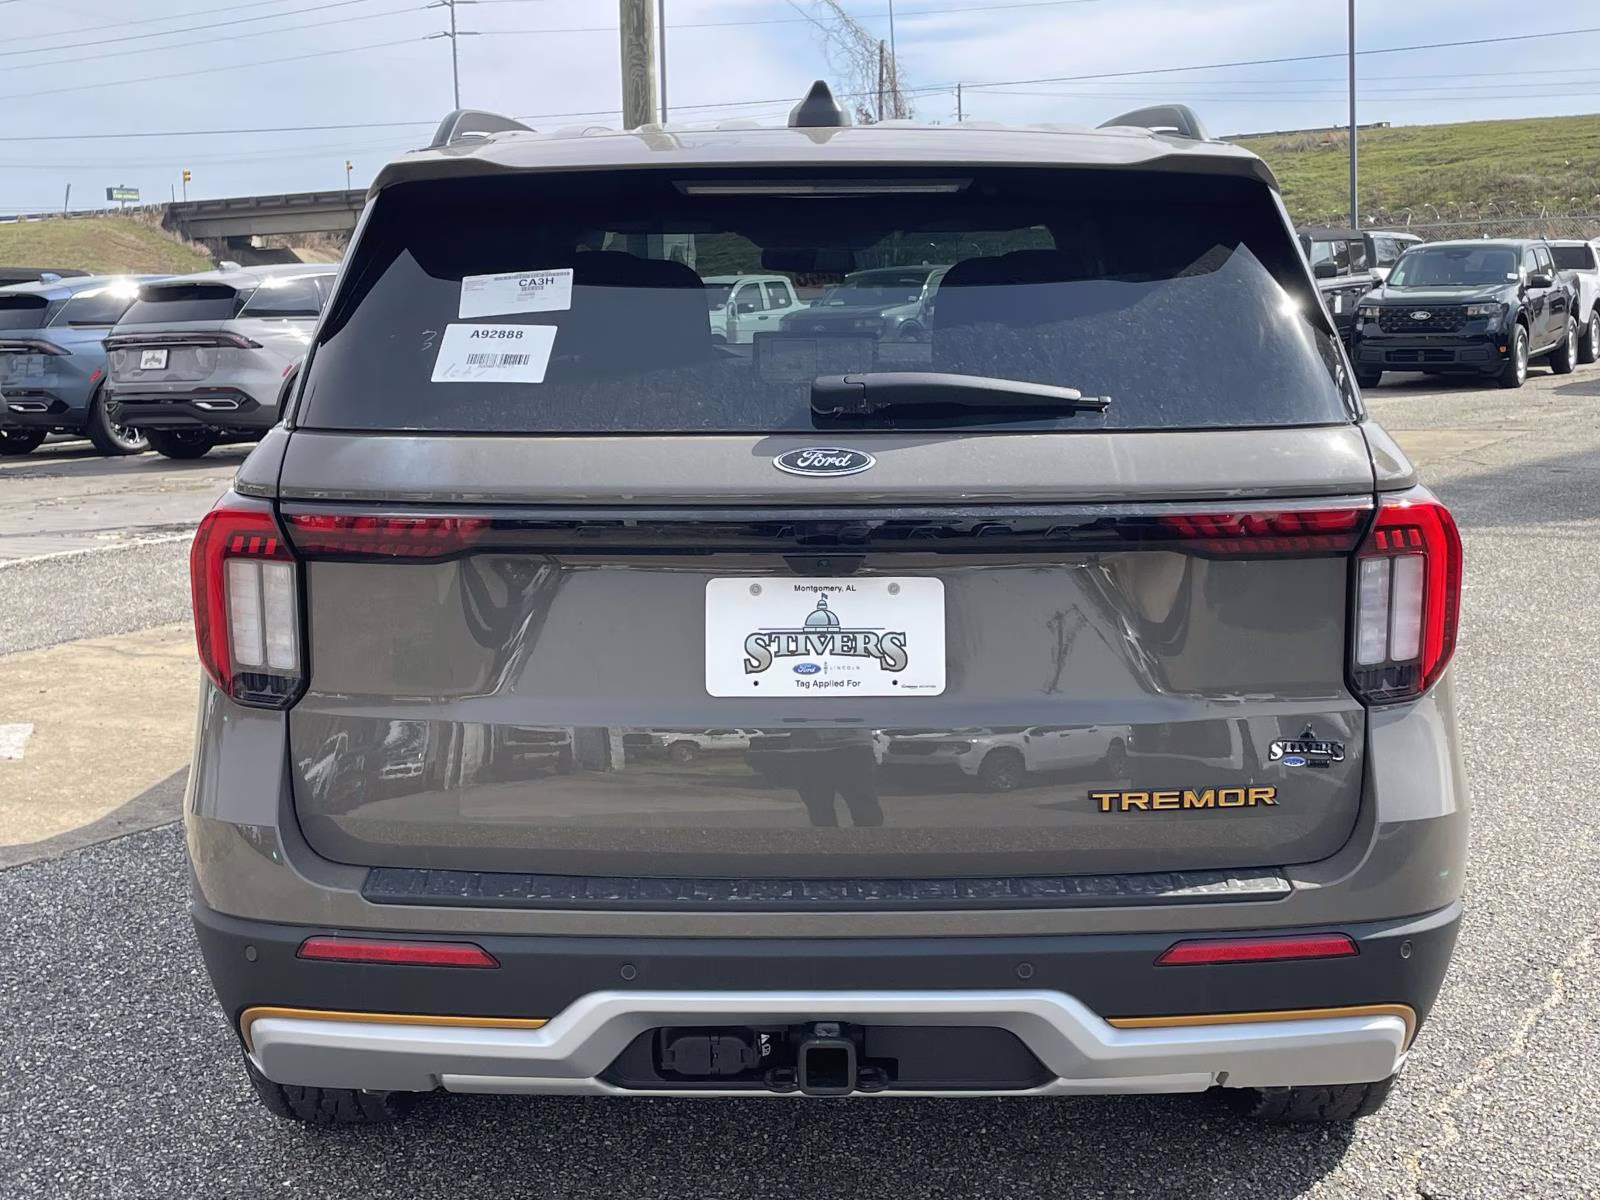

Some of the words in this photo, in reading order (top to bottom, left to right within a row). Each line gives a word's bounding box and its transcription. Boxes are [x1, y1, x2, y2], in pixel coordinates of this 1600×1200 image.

[518, 277, 554, 287] CA3H
[470, 330, 524, 339] A92888
[796, 449, 853, 467] Ford
[794, 584, 844, 593] Montgomery,
[845, 584, 857, 592] AL
[744, 631, 908, 675] STIVERS
[795, 680, 810, 689] Tag
[812, 680, 845, 689] Applied
[846, 680, 862, 688] For
[1089, 786, 1279, 813] TREMOR
